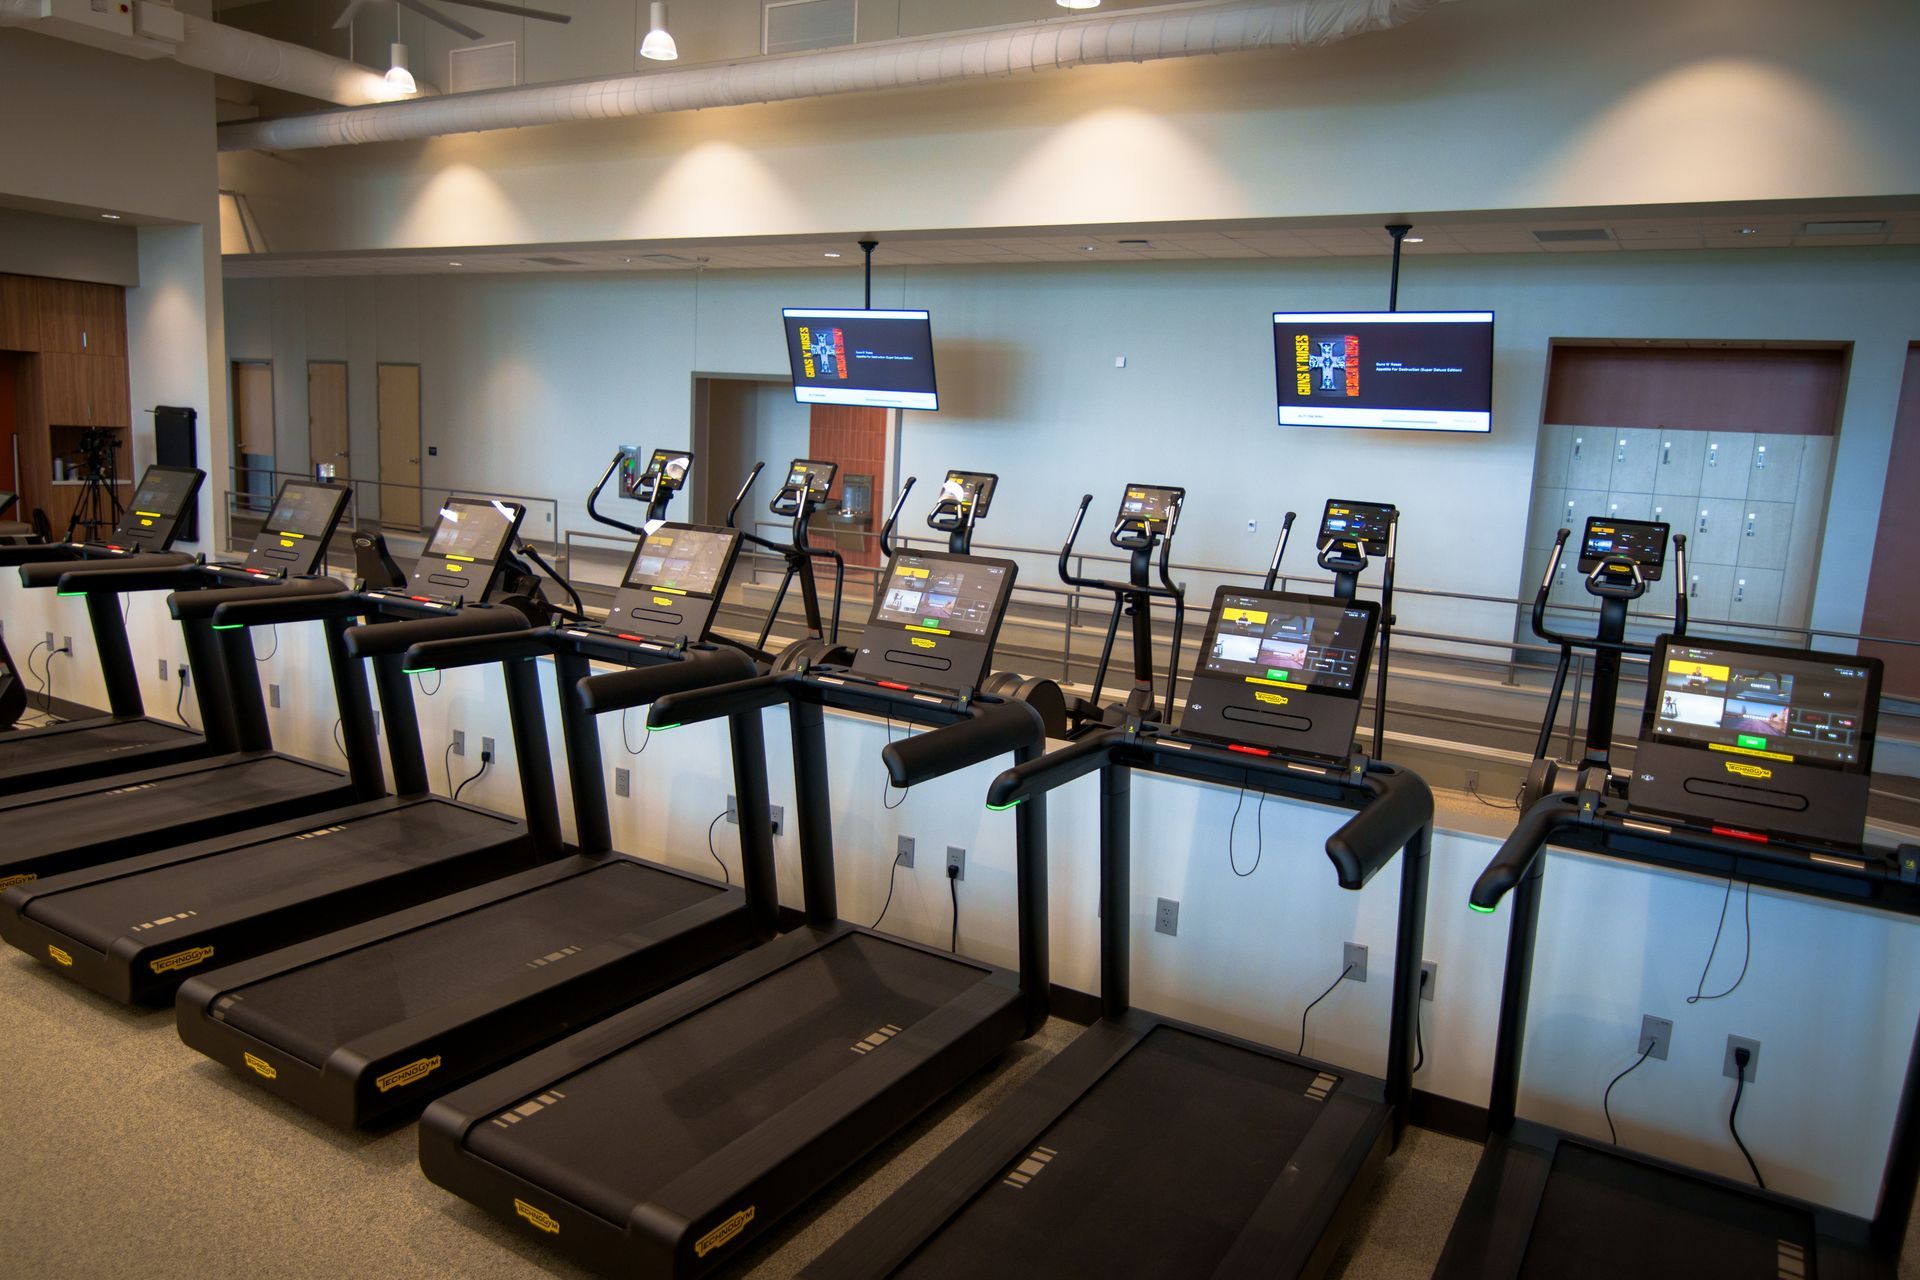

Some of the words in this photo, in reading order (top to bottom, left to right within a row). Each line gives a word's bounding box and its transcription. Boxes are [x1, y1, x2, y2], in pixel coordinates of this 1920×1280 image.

[799, 327, 811, 350] ROSES
[1295, 335, 1309, 363] ROSES
[803, 358, 815, 378] GUNS
[1297, 373, 1311, 395] GUNS
